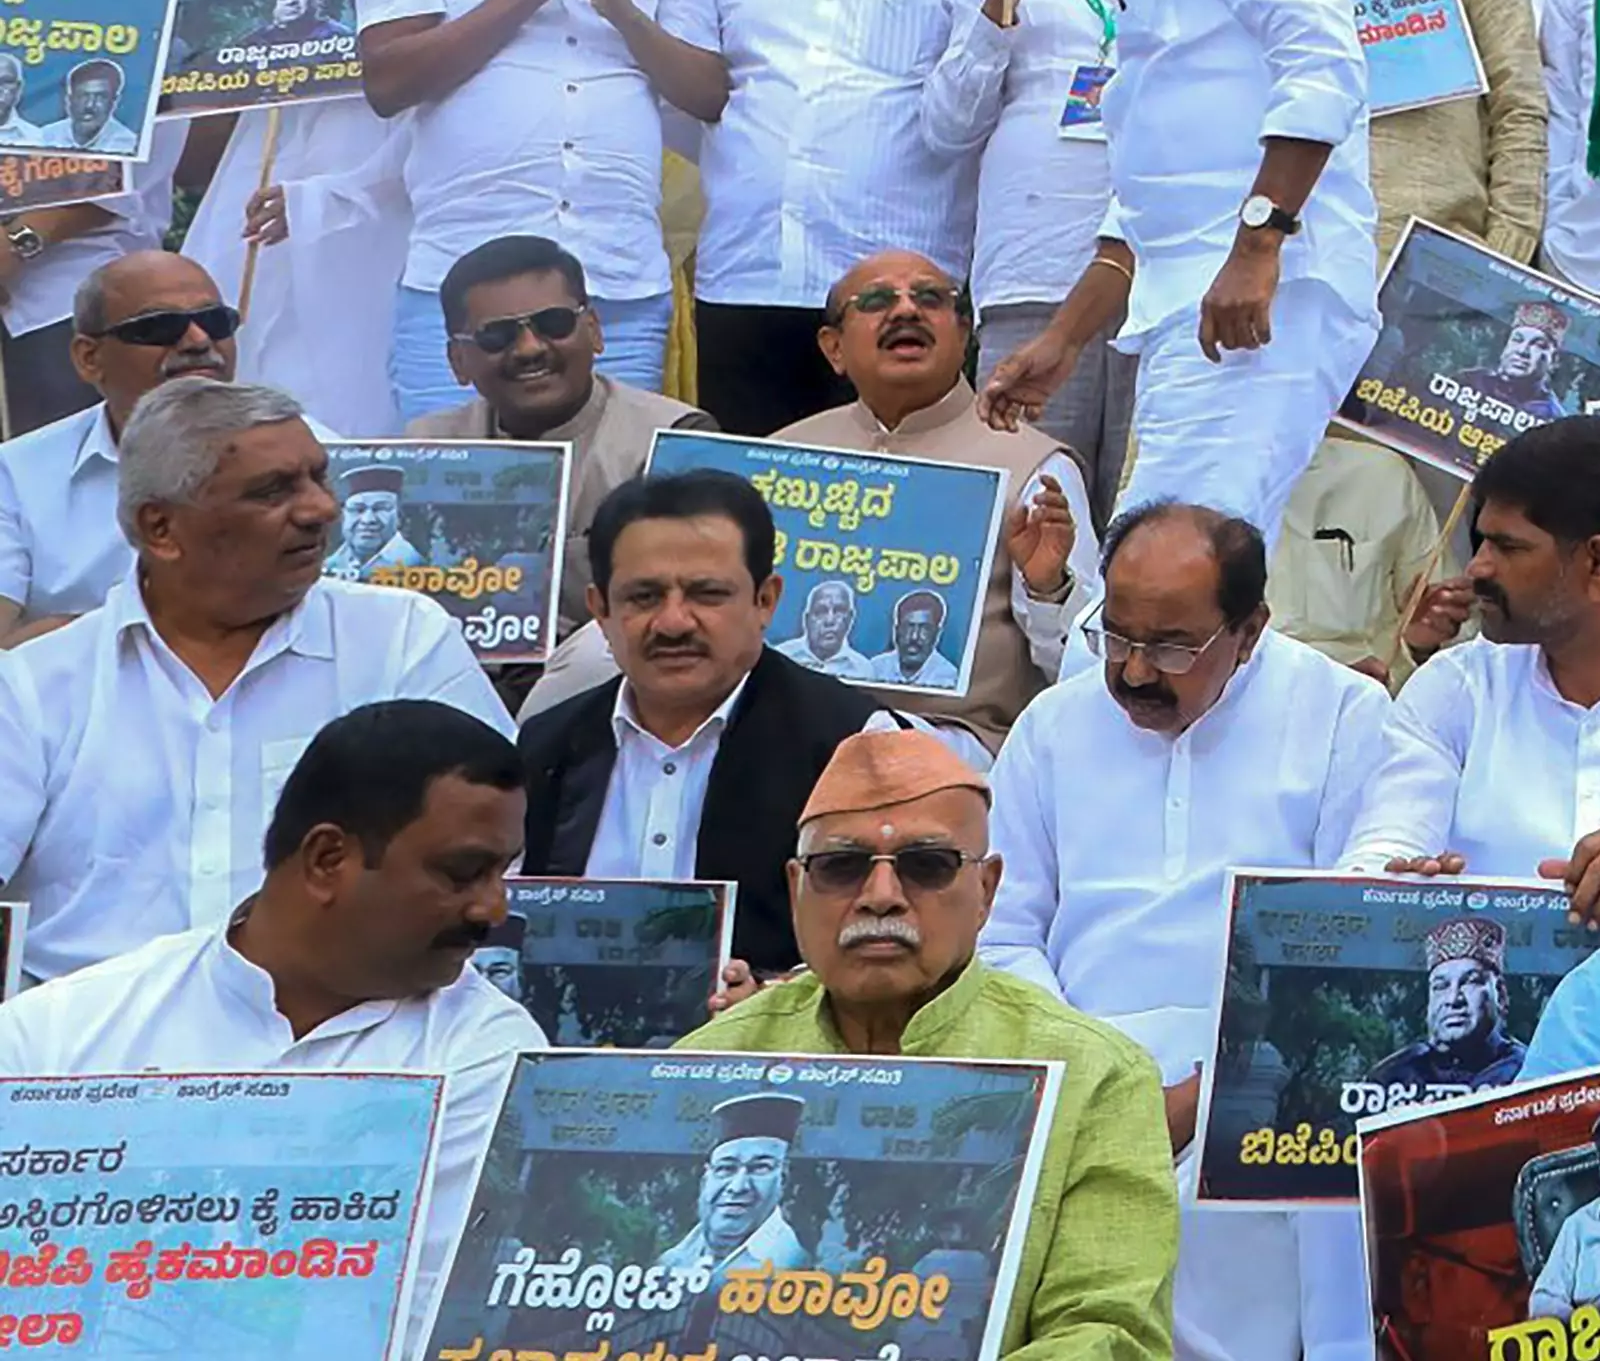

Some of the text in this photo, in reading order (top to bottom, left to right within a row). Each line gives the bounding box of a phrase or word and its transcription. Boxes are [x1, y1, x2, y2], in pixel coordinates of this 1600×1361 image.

[0, 17, 138, 63] ಜ್ಯಪಾಲ
[1357, 9, 1446, 44] ಮಾಂಡಿನ
[217, 36, 355, 69] ರಾಜ್ಯಪಾಲರಲ್ಲ
[314, 60, 362, 81] ಪಾಲ
[1356, 379, 1455, 436] ಬಿಜೆಪಿಯ
[1429, 373, 1554, 434] ರಾಜ್ಯಪಾಲ
[795, 537, 960, 593] ರಾಜ್ಯಪಾಲ
[462, 606, 540, 649] ವೋ
[10, 1082, 291, 1104] ಕರ್ನಾಟಕ ಪ್ರದೇಶ ಕಾಂಗ್ರೆಸ್ ಸಮಿತಿ
[1494, 1098, 1557, 1127] ಕರ್ನಾಟಕ
[0, 1142, 127, 1175] ಸರ್ಕಾರ
[251, 1188, 279, 1235] ಕೈ
[290, 1189, 400, 1222] ಹಾಕಿದ
[104, 1238, 379, 1299] ಹೈಕಮಾಂಡಿನ
[488, 1247, 948, 1331] ಗೆಹ್ಲೋಟ್ ಹಠಾವೋ
